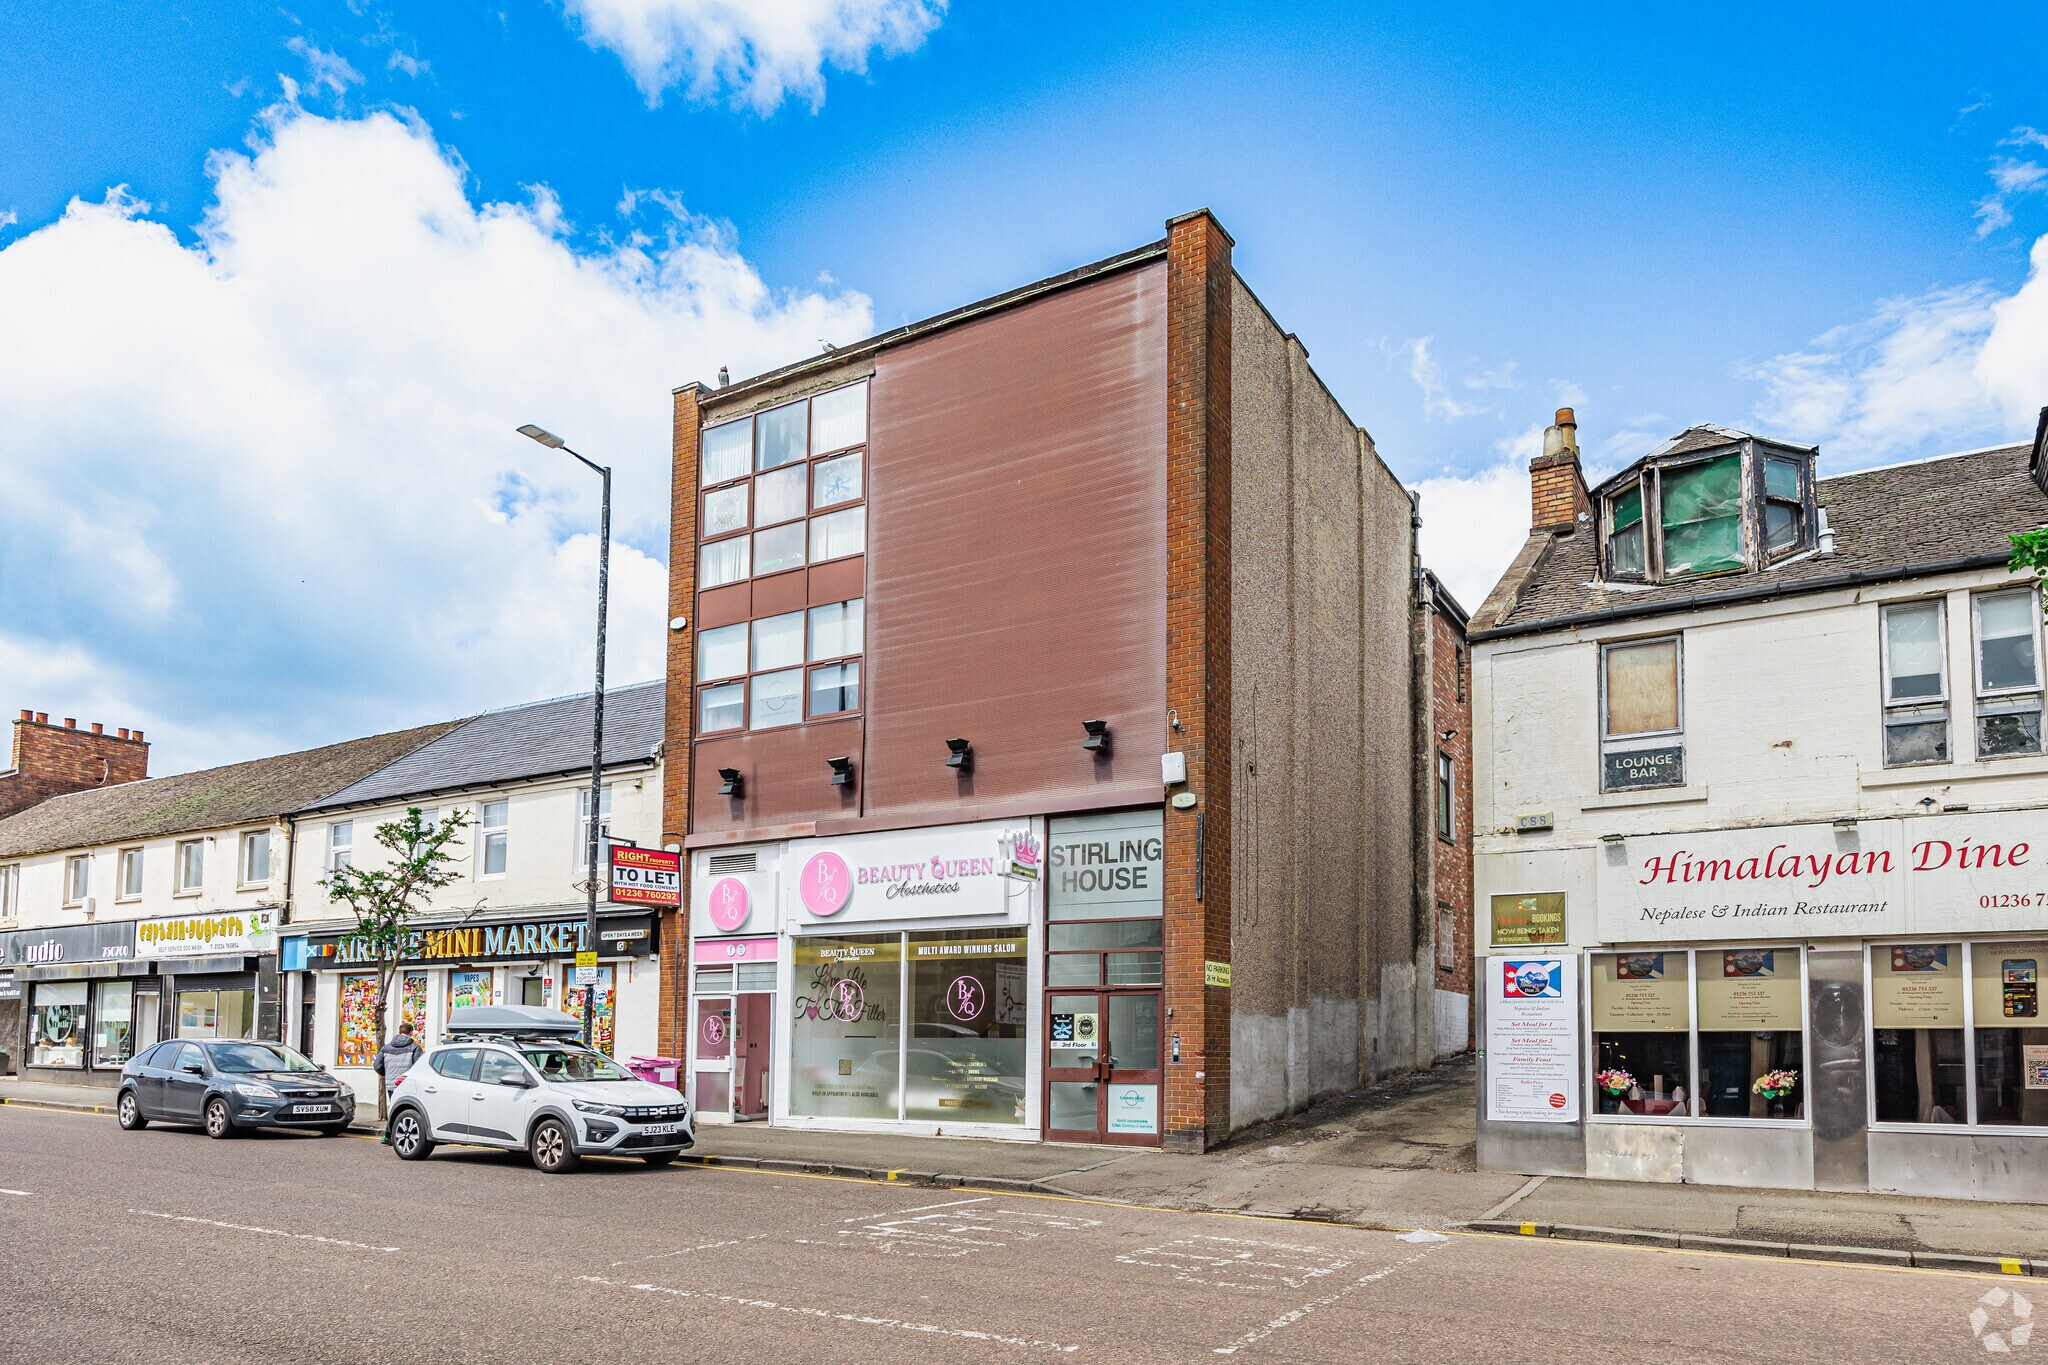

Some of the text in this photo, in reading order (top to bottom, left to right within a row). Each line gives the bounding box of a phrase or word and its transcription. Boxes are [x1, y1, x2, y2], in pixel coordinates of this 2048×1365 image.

[1616, 754, 1673, 769] LOUNGE
[1630, 767, 1658, 779] BAR
[617, 851, 650, 862] RIGHT
[1050, 838, 1162, 867] STIRLING
[1639, 837, 2029, 888] Himalayan Dine
[616, 867, 675, 885] TO LET
[858, 862, 926, 885] BEAUTY
[931, 856, 994, 880] QUEEN
[1062, 866, 1147, 893] HOUSE
[616, 888, 677, 900] 01236 760292
[885, 881, 960, 900] Aesthetics
[1979, 894, 2030, 909] 01236
[1532, 913, 1562, 923] BOOKINGS
[1639, 900, 1889, 925] Nepalese & Indian Restaurant
[1497, 927, 1516, 935] NOW
[1538, 926, 1560, 934] TAKEN
[425, 928, 480, 958] MINI
[484, 922, 588, 955] MARKET
[102, 945, 129, 958] 750700
[821, 947, 875, 957] BEAUTY QUEEN
[918, 944, 1016, 955] MULTI AWARD WINNING SALON
[1206, 964, 1230, 974] NO PARKING
[463, 973, 480, 983] VAPES
[644, 1125, 674, 1134] SJ23 KLE
